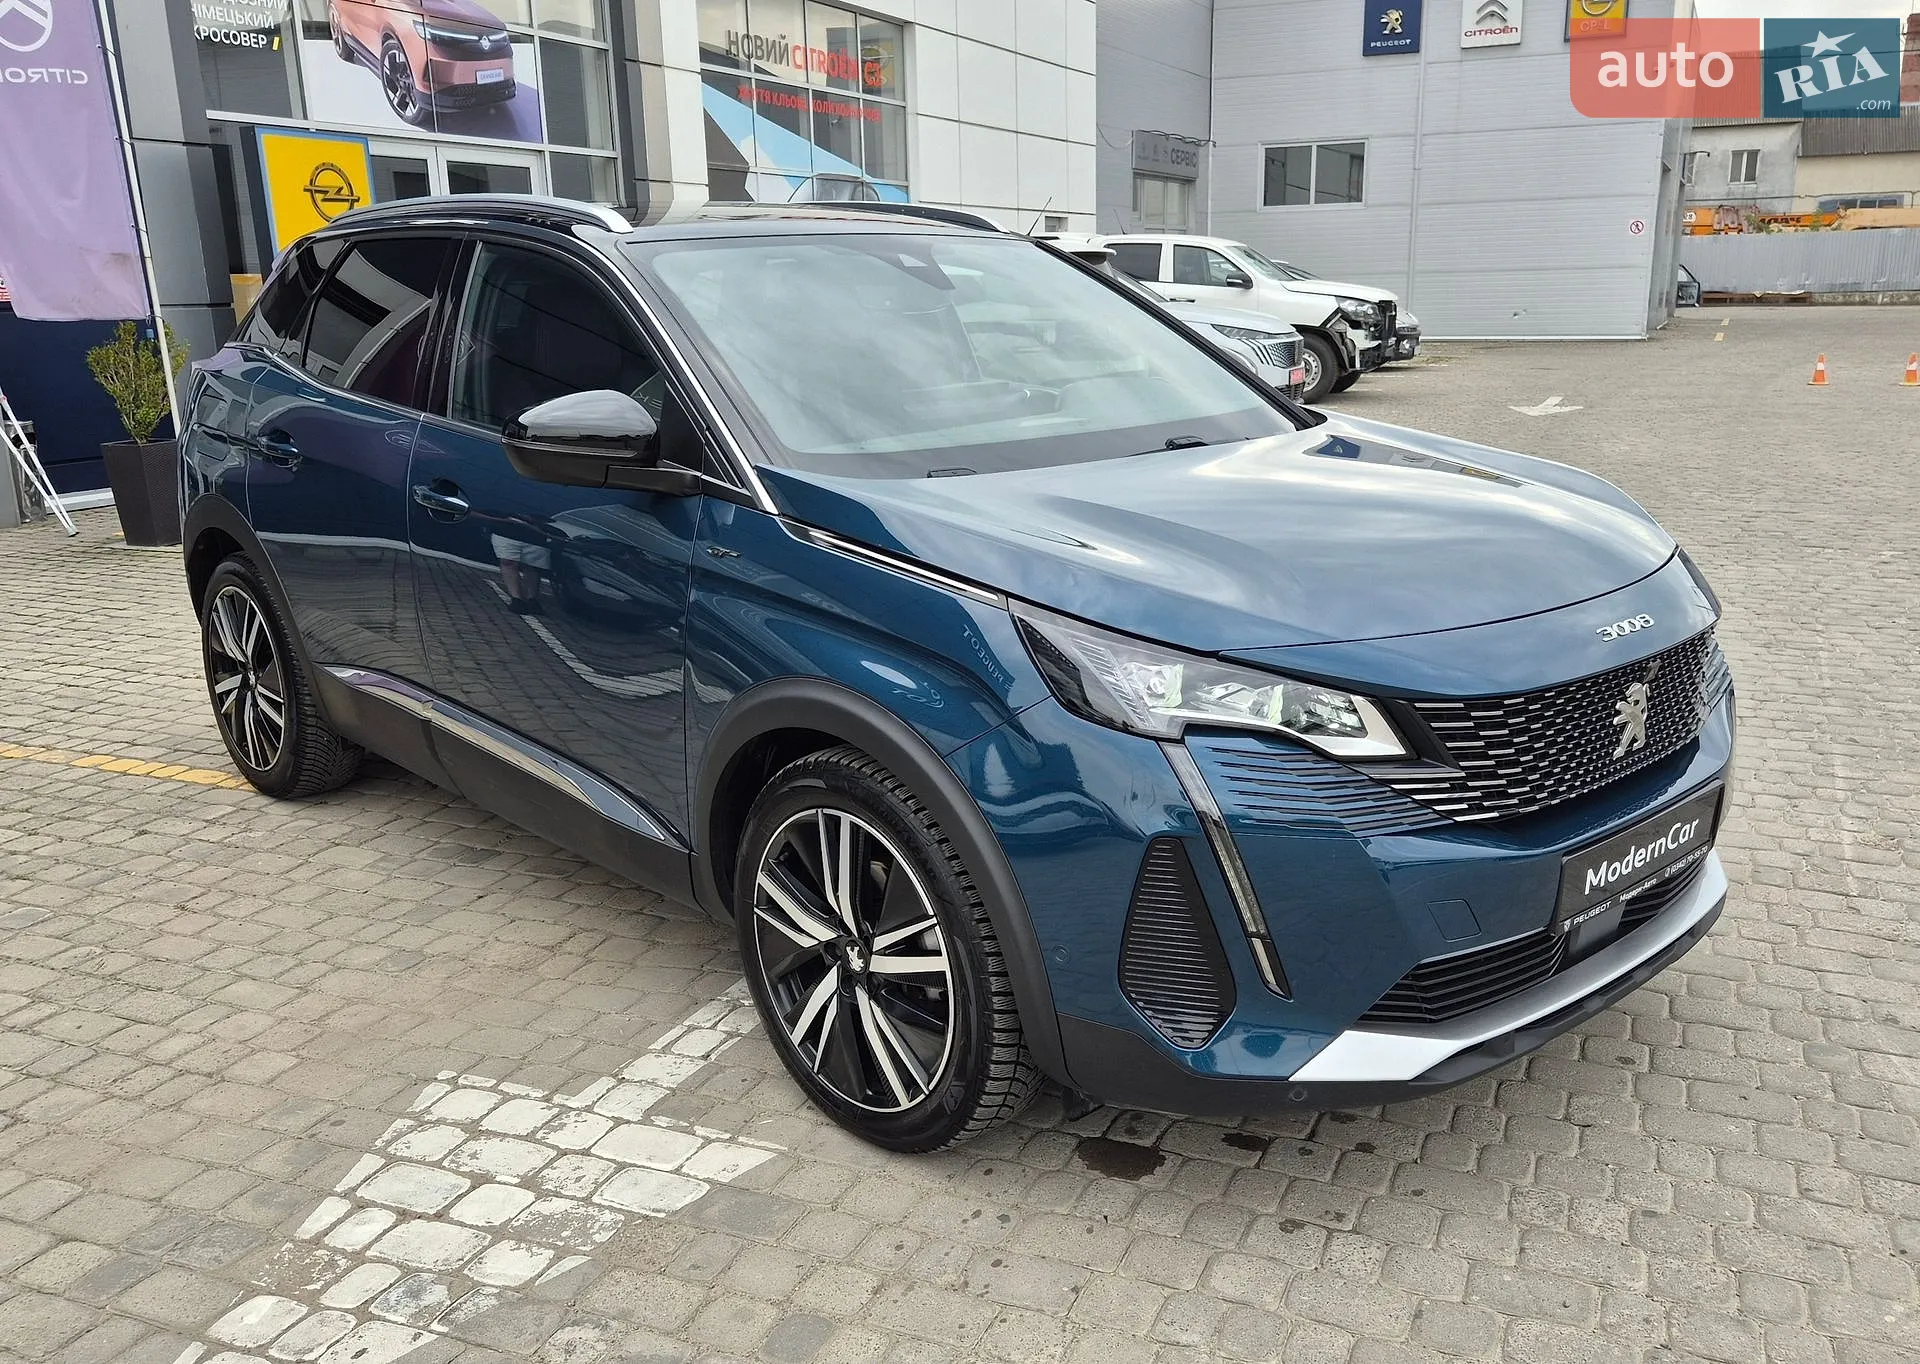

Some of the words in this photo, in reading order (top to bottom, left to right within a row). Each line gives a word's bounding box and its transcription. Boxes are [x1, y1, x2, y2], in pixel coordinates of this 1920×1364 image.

[726, 30, 790, 67] НОВИЙ
[1370, 39, 1412, 48] PEUGEOT
[1596, 613, 1655, 642] 3008
[1584, 819, 1700, 895] ModernCar
[1573, 901, 1612, 926] PEUGEOT
